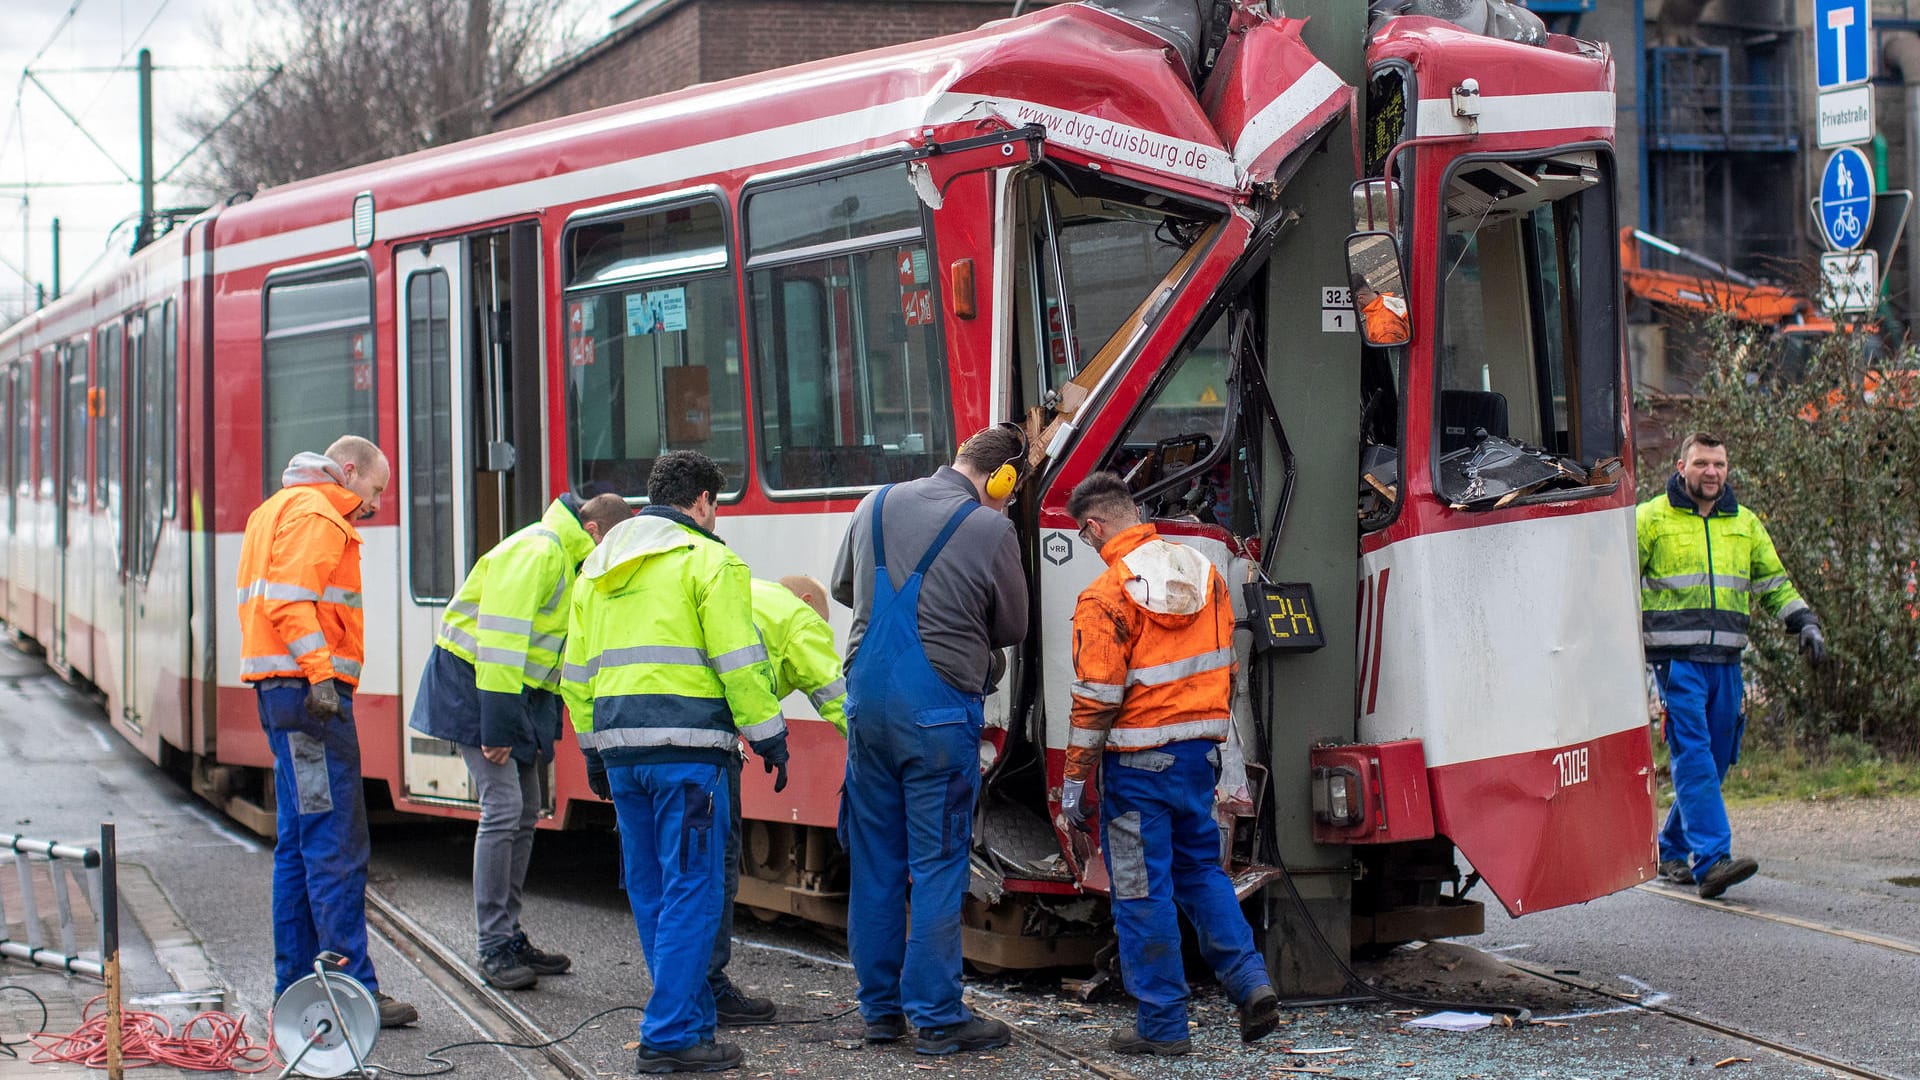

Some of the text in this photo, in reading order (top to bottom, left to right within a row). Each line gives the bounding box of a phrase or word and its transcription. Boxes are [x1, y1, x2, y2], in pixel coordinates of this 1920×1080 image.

[1822, 105, 1868, 128] Privatstraße
[1018, 106, 1207, 169] www.dvg-duisburg.de
[1326, 290, 1353, 306] 32,3
[1334, 315, 1342, 328] 1
[1266, 595, 1314, 638] 24
[1552, 747, 1588, 787] 1009
